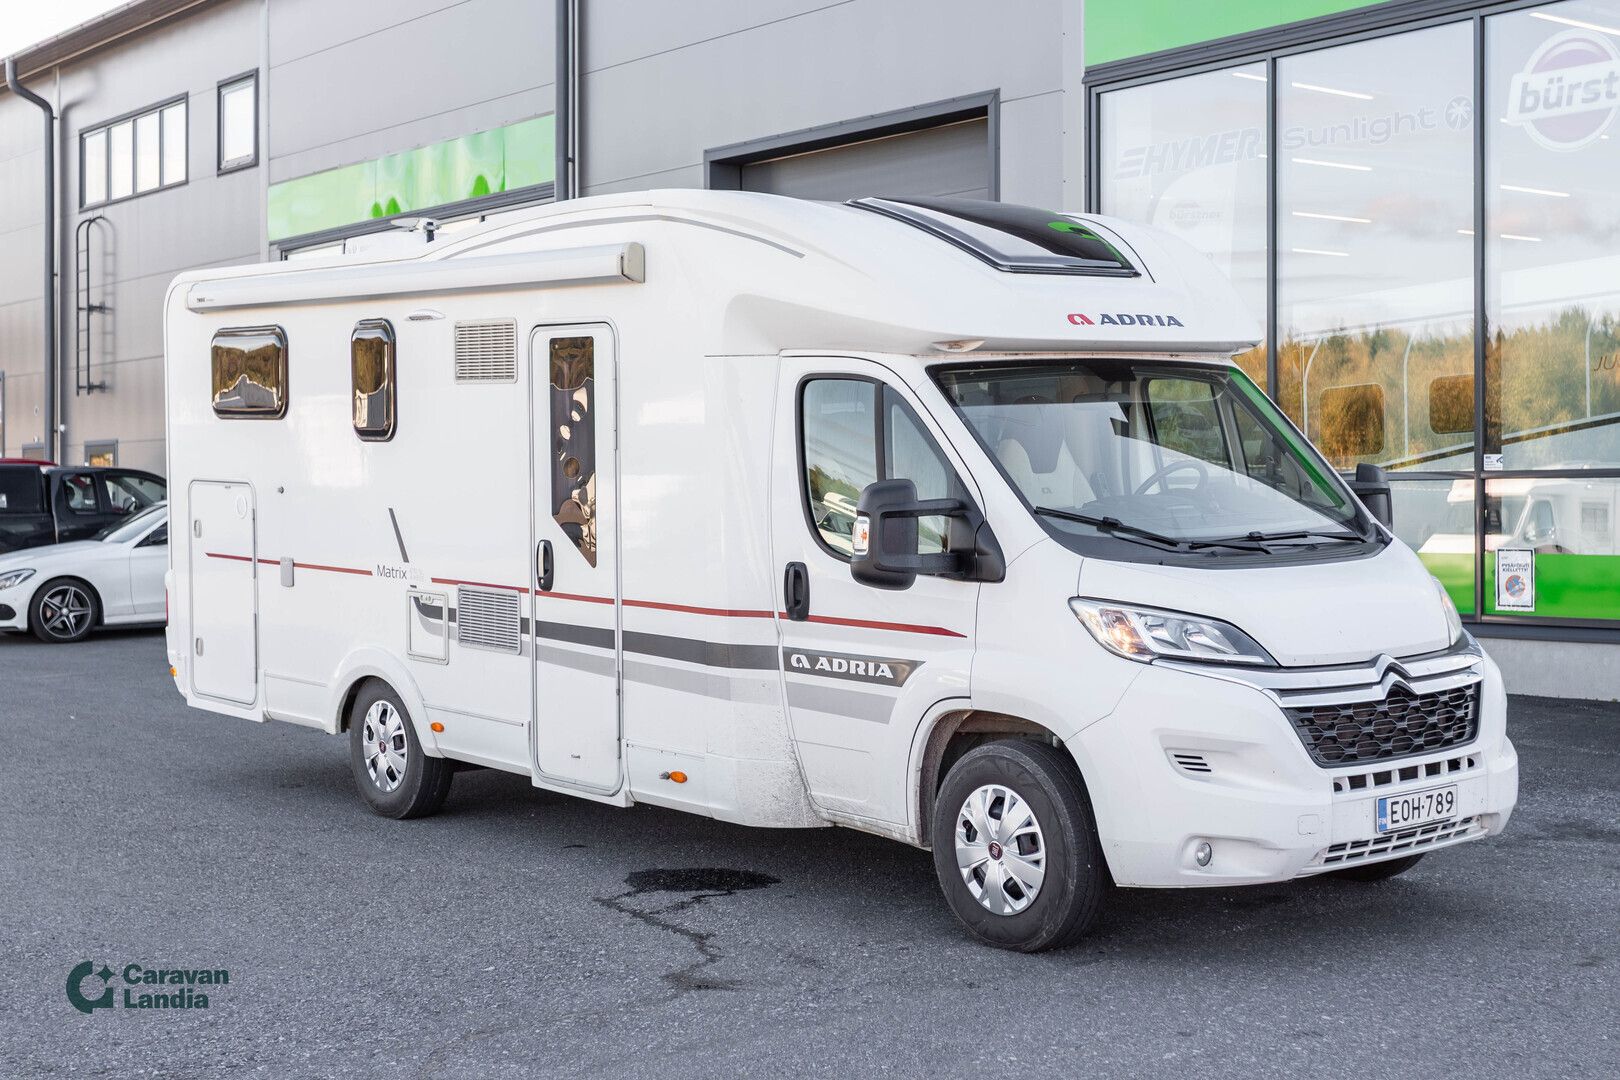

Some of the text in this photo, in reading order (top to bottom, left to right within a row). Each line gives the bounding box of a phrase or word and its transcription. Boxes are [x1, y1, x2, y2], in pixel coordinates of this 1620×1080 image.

[1519, 70, 1620, 114] bürst
[1141, 127, 1261, 176] HYMER
[1100, 313, 1184, 327] ADRIA
[377, 565, 407, 579] Matrix
[815, 656, 894, 679] ADRIA
[1390, 790, 1454, 825] EOH-789
